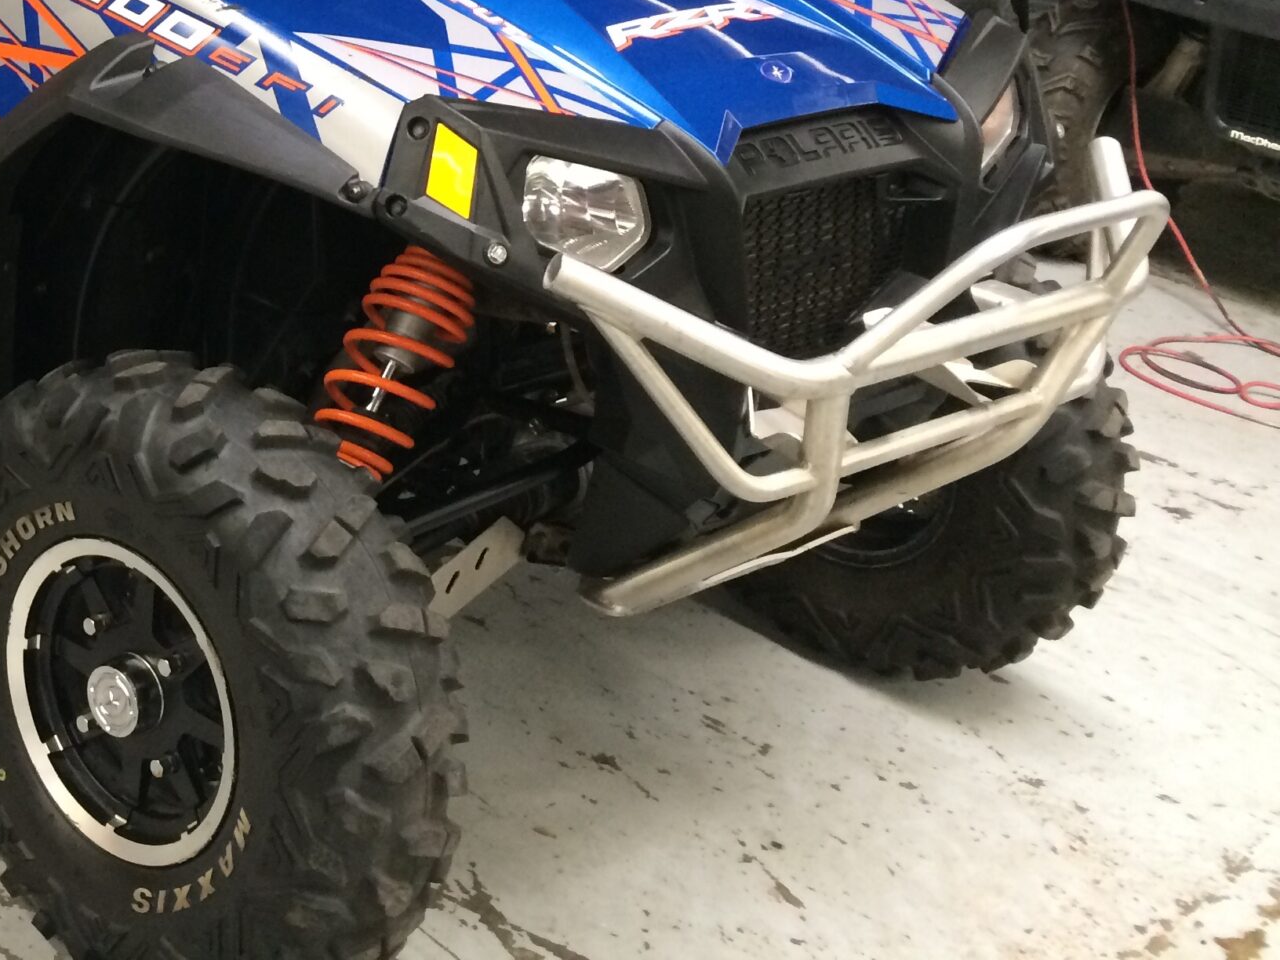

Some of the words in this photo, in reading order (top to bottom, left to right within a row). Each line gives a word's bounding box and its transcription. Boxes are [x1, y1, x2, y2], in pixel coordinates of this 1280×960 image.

[606, 0, 777, 52] RZR
[207, 45, 342, 118] EFI
[735, 117, 903, 176] POLARIS
[1230, 130, 1280, 152] MacPhe
[131, 807, 252, 914] MAXXIS
